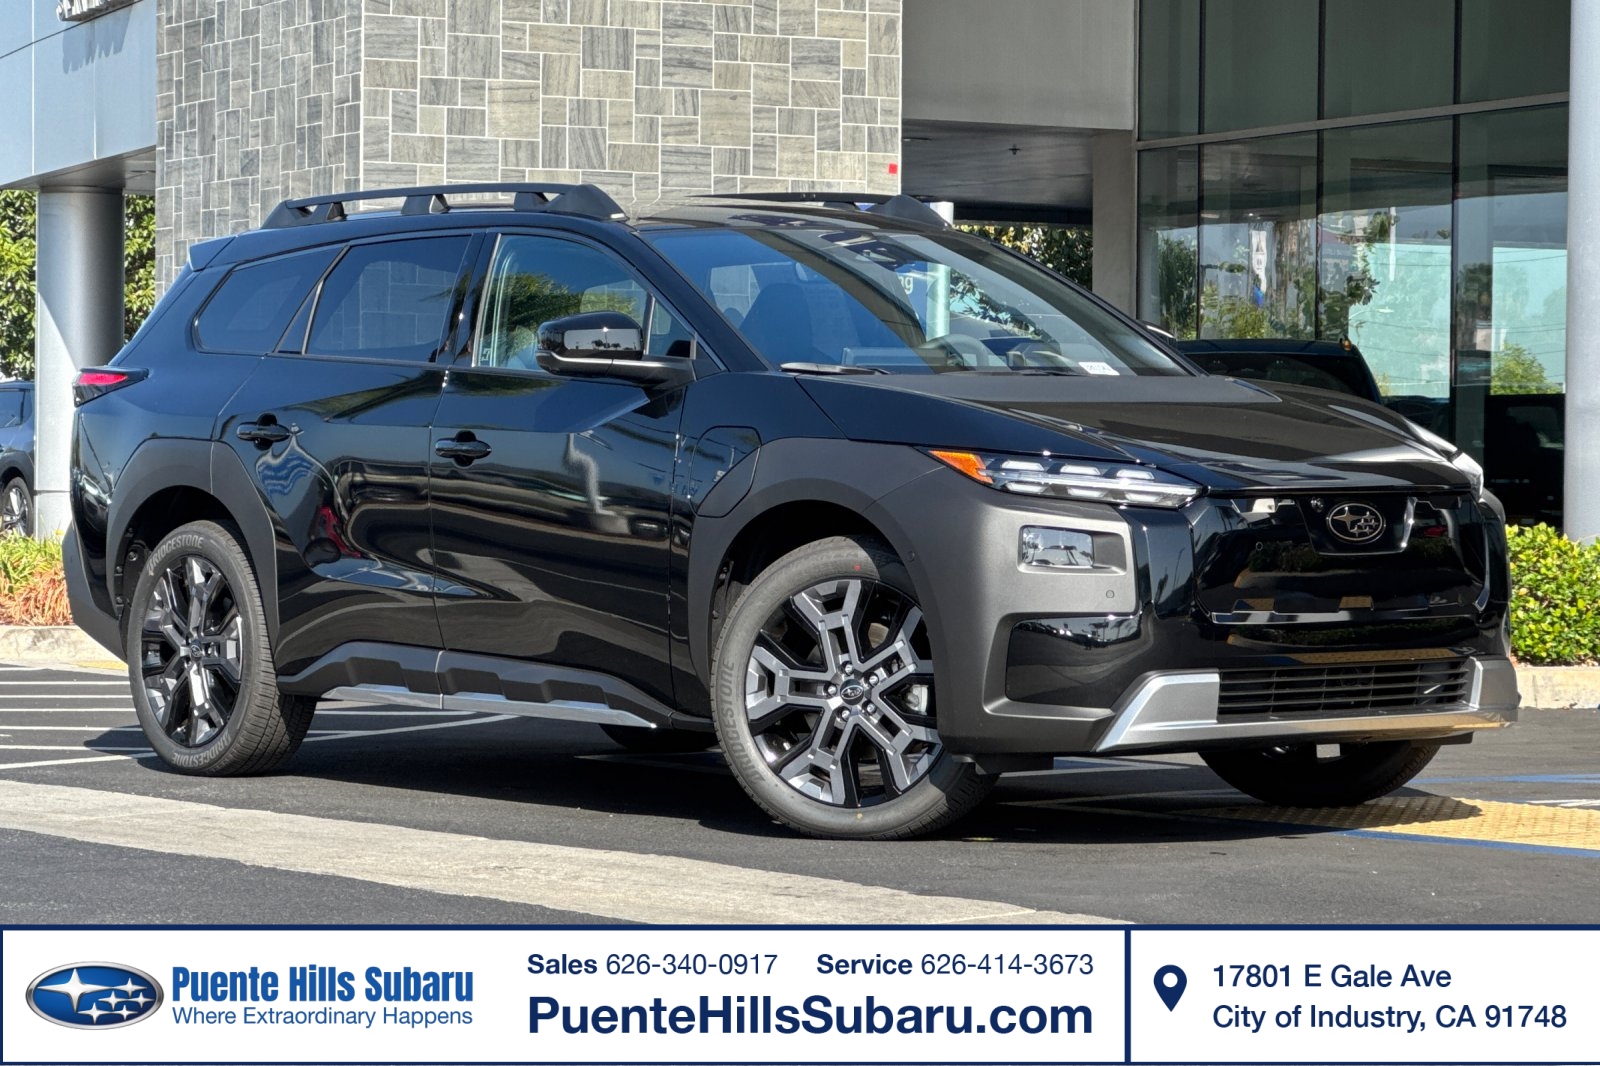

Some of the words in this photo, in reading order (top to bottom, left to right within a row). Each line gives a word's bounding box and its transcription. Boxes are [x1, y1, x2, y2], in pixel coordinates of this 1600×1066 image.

[146, 534, 204, 576] BRIDGESTONE
[720, 659, 766, 786] BRIDGESTONE
[171, 727, 232, 768] BRIDGESTONE
